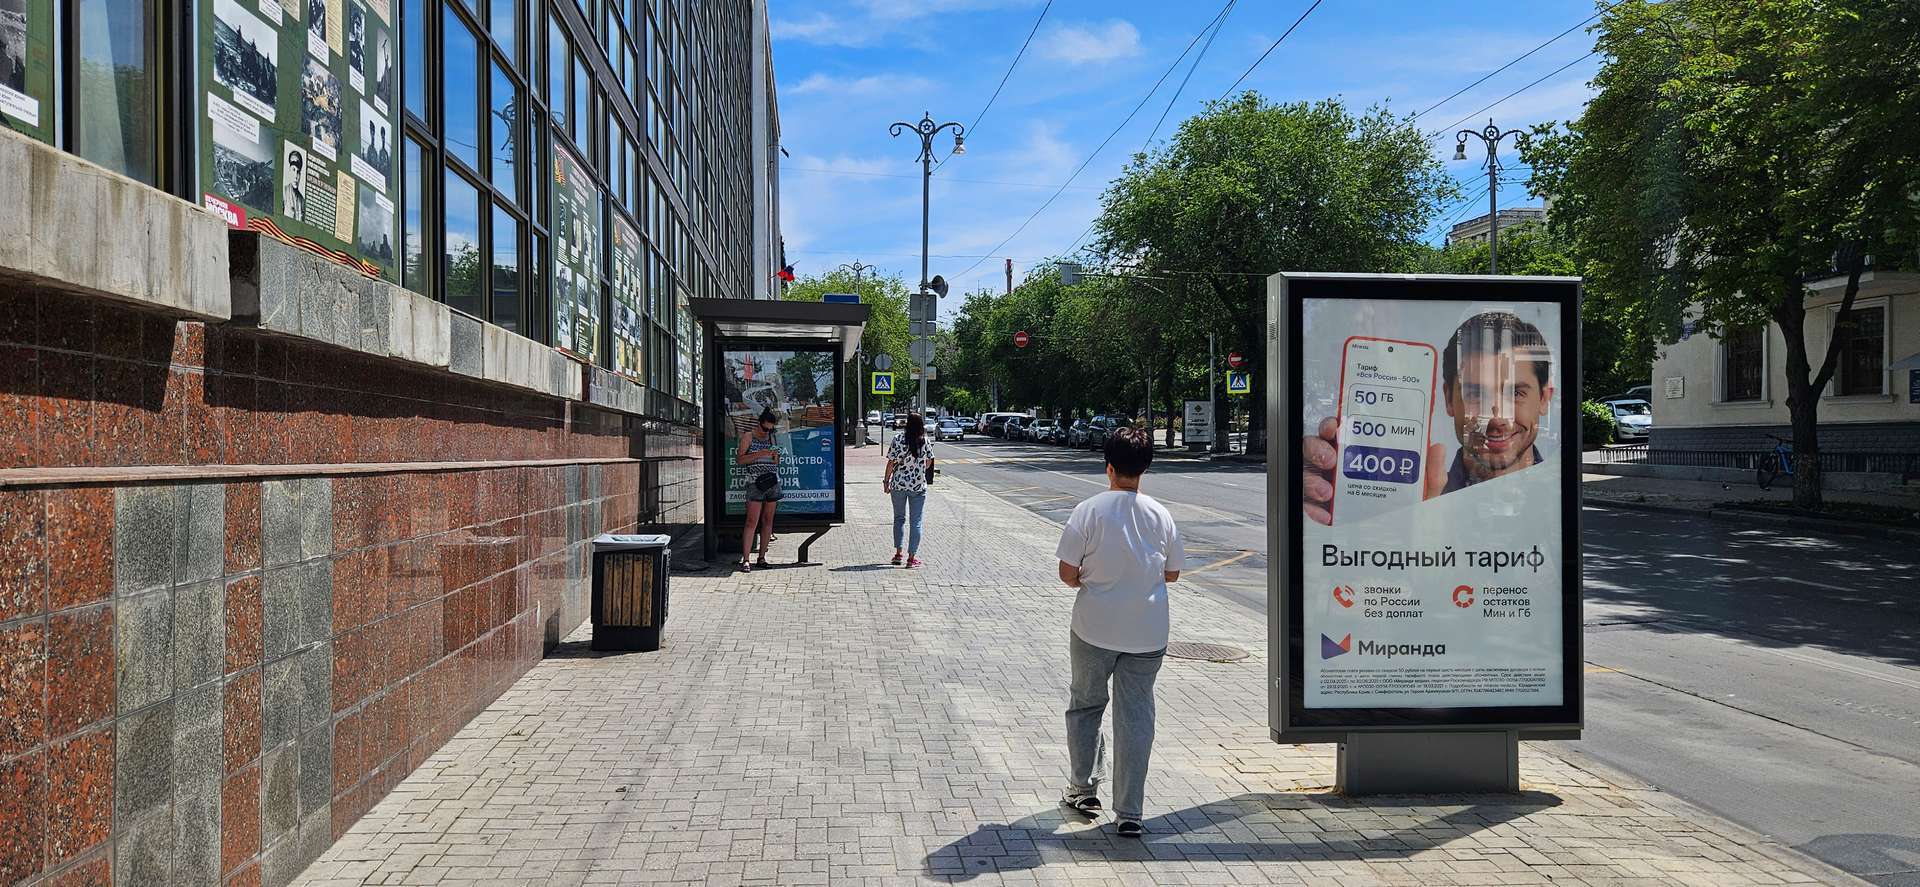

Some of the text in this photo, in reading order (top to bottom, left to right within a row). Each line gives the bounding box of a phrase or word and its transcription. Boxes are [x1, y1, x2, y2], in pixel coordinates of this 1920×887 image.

[1357, 363, 1378, 372] Тариф
[1373, 372, 1397, 381] Россия
[1354, 390, 1394, 405] 50 ГБ
[1352, 421, 1415, 437] 500 МИН
[1349, 453, 1396, 475] 400
[1322, 544, 1545, 573] Выгодный тариф
[1364, 586, 1401, 594] звонки
[1483, 586, 1528, 596] перенос
[1364, 597, 1420, 606] по России
[1483, 598, 1530, 606] остатков
[1364, 608, 1423, 619] без доплат
[1483, 608, 1531, 618] Мин и Гб
[1358, 640, 1446, 659] Миранда
